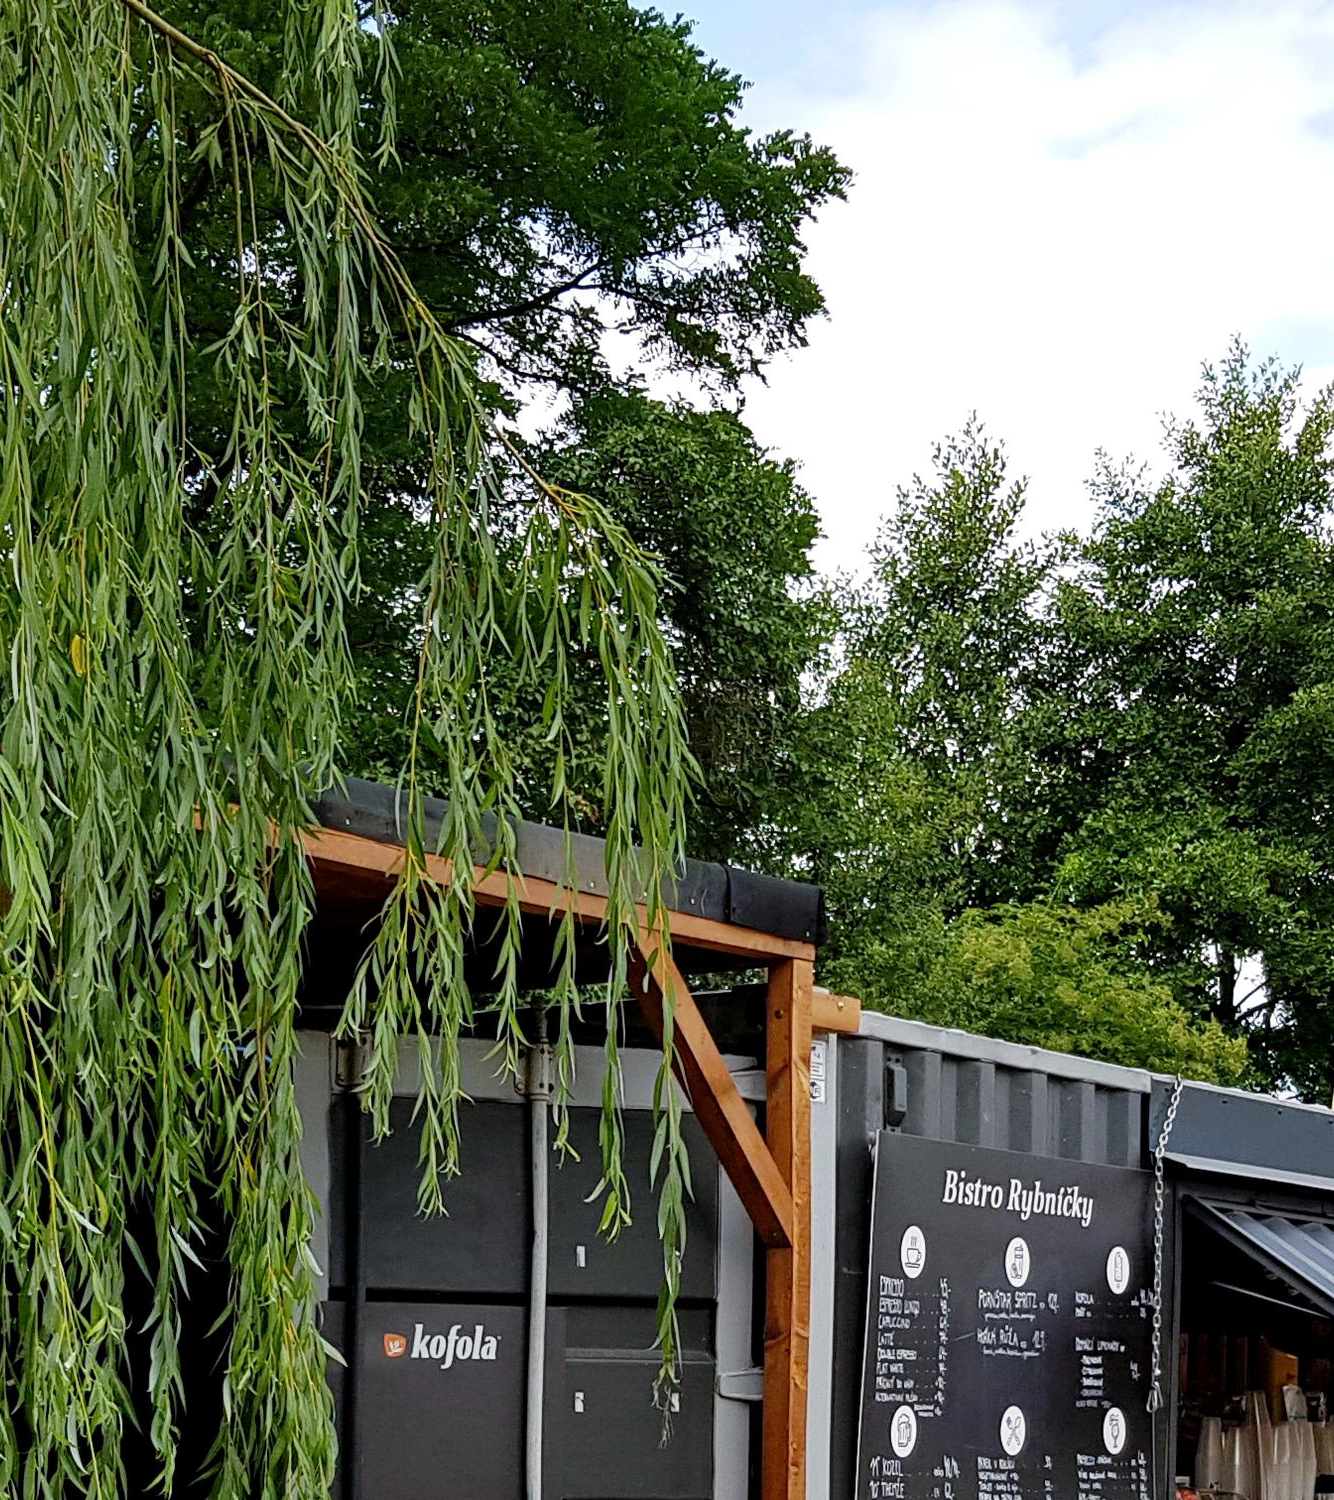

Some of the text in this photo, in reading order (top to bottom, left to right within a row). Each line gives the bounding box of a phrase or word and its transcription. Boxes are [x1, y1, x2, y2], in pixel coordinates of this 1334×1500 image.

[942, 1169, 1094, 1228] Bistro Rybníčky
[410, 1323, 498, 1370] kofola
